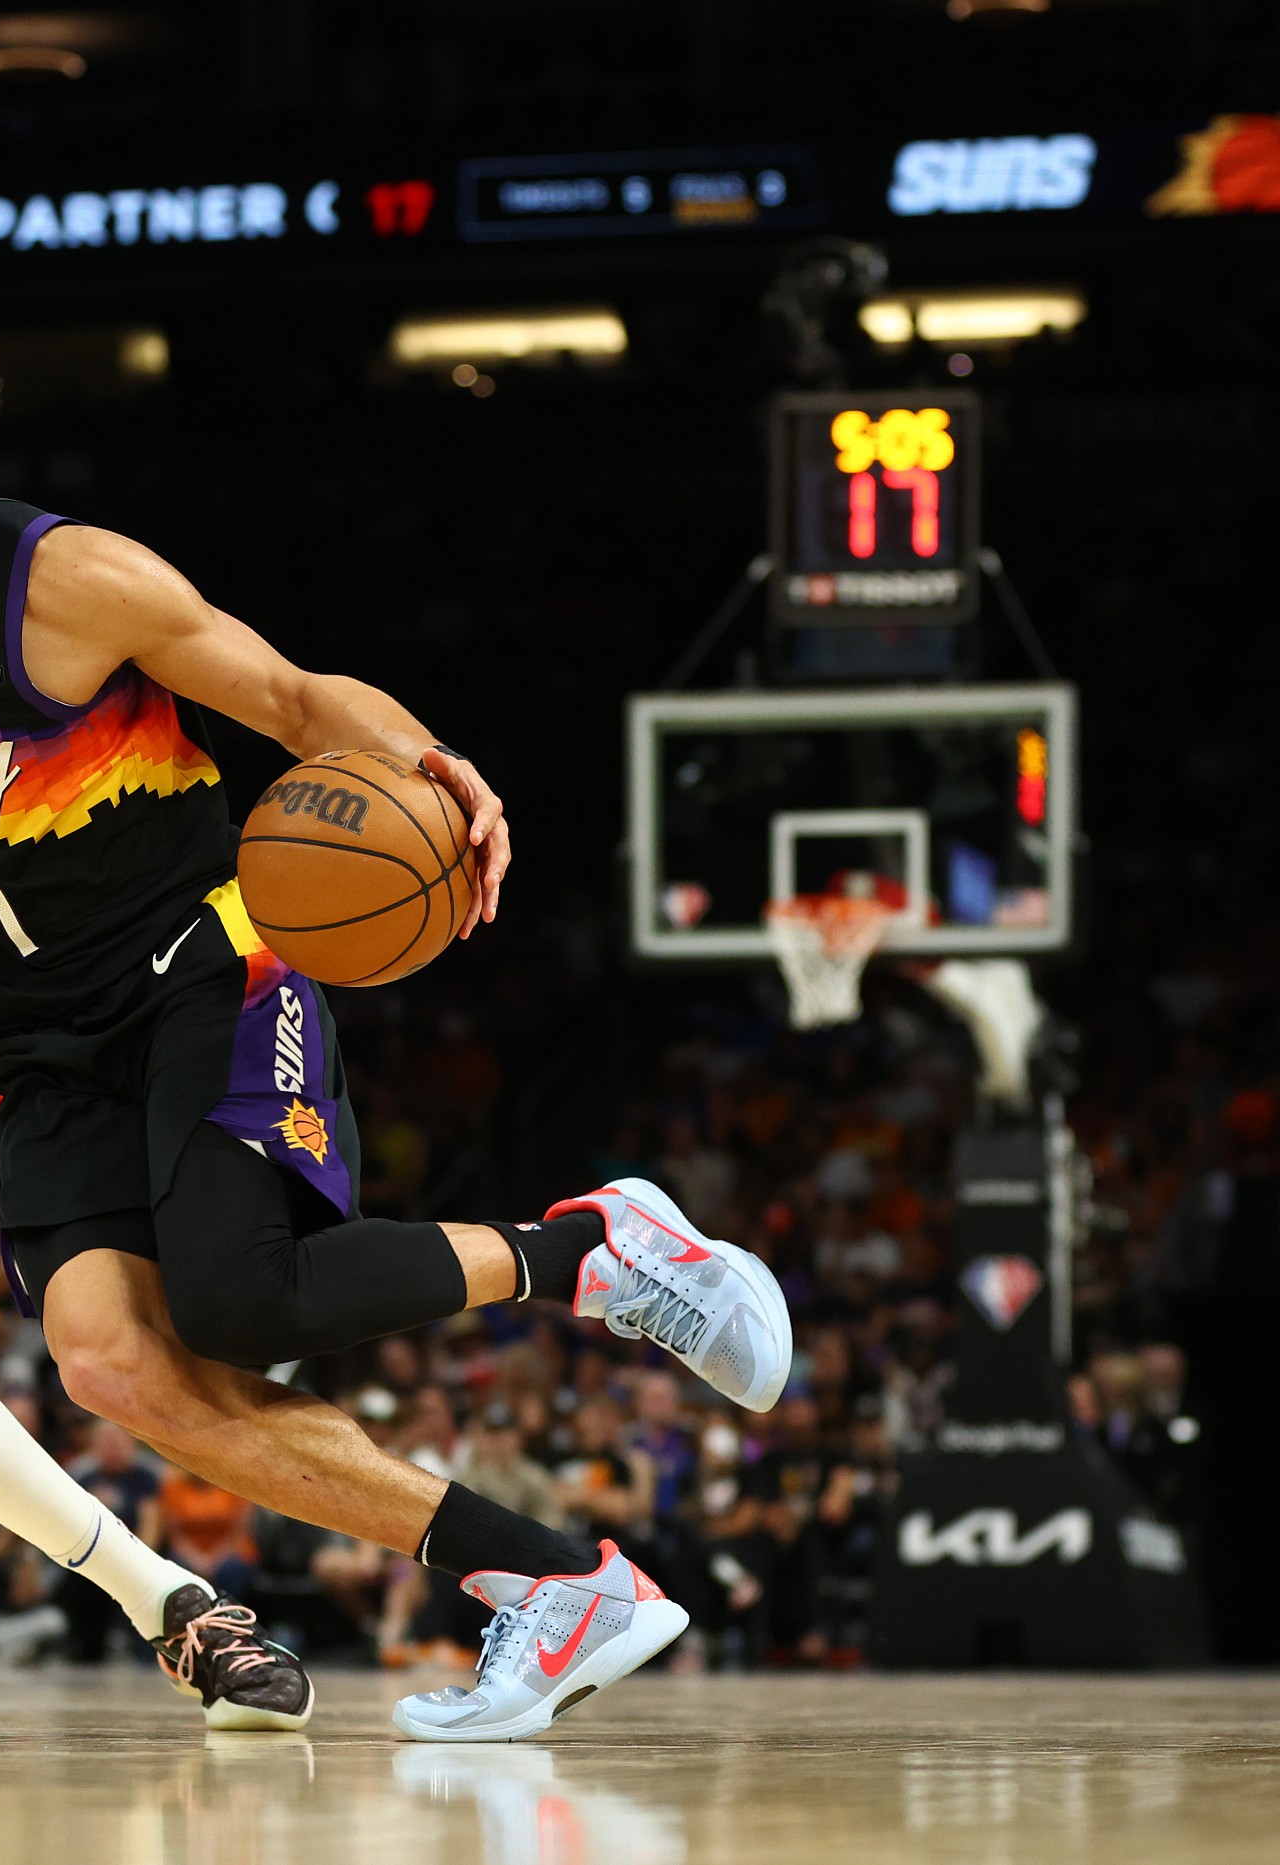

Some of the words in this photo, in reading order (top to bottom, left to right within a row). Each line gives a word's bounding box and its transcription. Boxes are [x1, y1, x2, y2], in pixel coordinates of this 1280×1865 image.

[888, 133, 1098, 216] SUNS
[831, 408, 956, 474] 5:05
[847, 467, 940, 559] 17
[254, 780, 370, 836] Wilso
[274, 986, 305, 1093] SUNS
